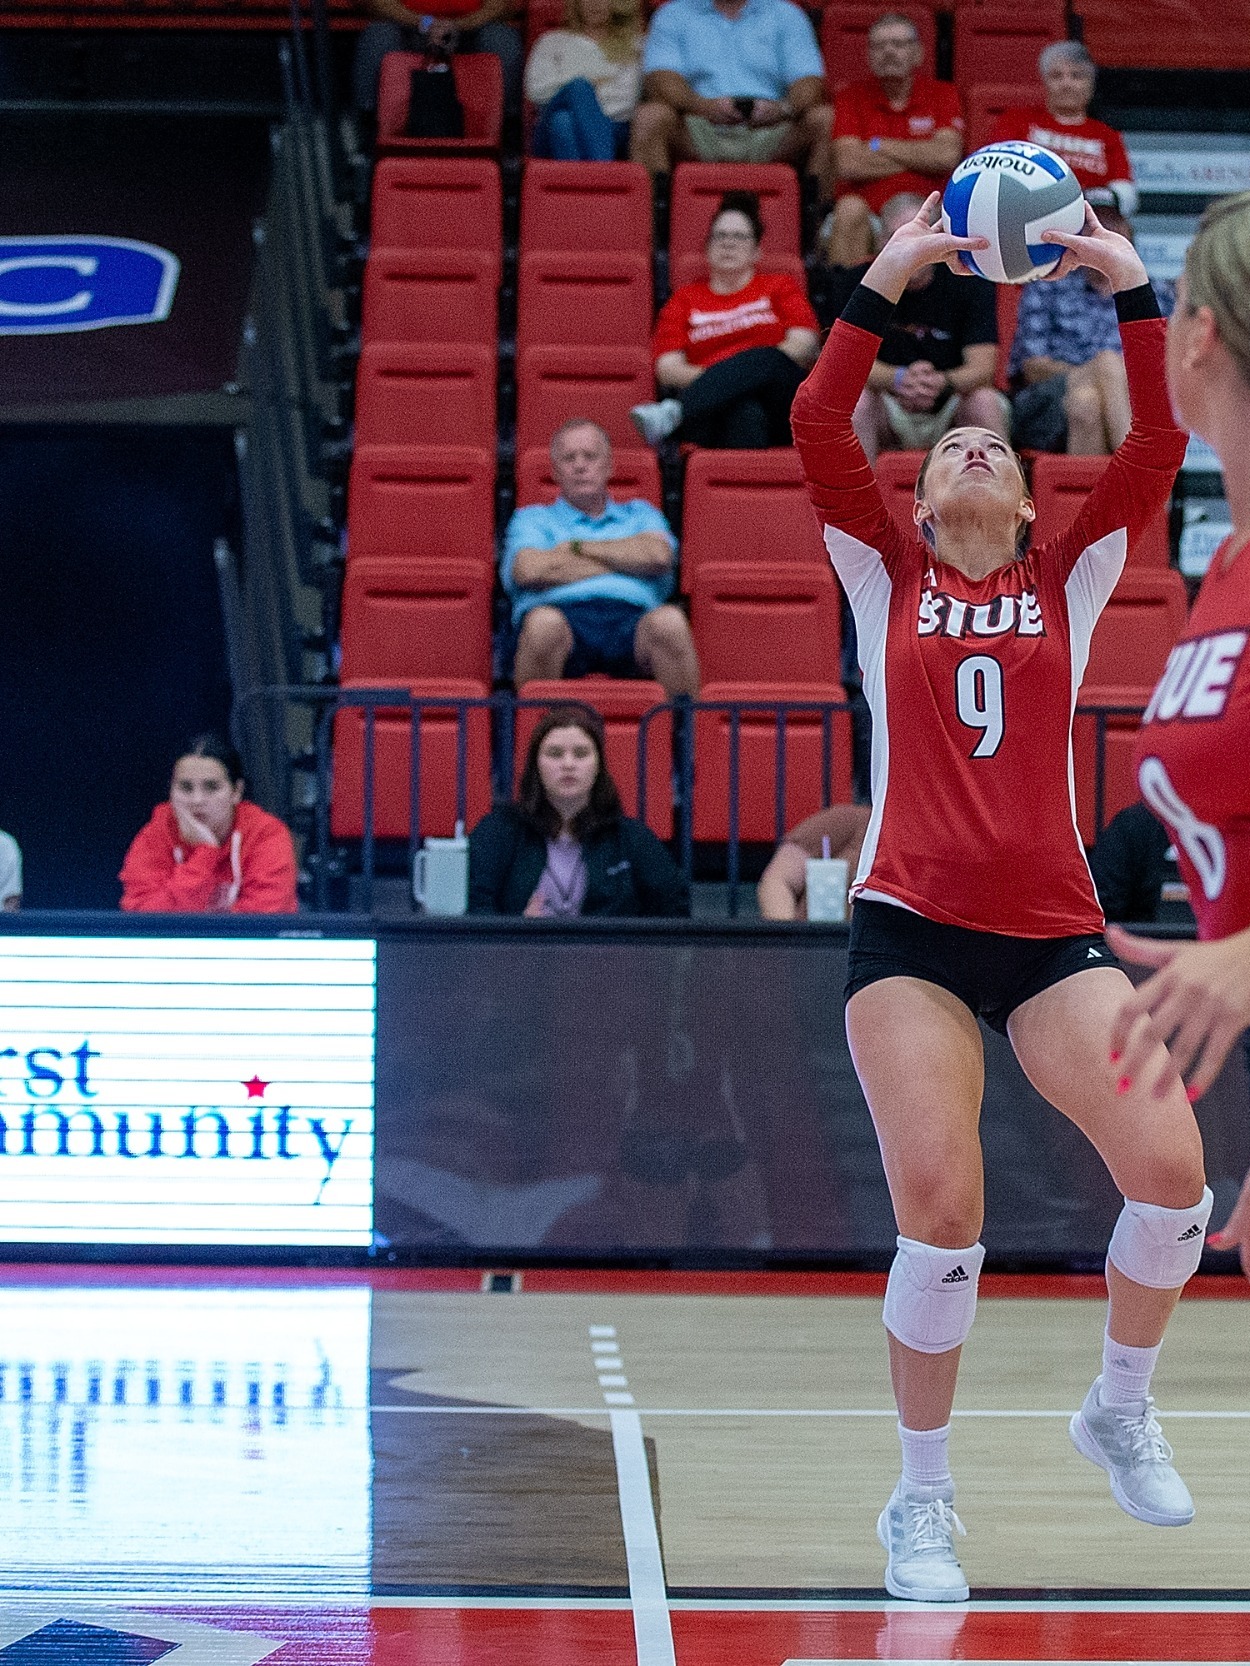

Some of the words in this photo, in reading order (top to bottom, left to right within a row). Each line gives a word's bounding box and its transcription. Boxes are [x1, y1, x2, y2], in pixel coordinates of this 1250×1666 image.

[962, 155, 1036, 176] molten
[917, 588, 1046, 638] SIUE
[955, 653, 1005, 759] 9
[941, 1274, 969, 1284] adidas
